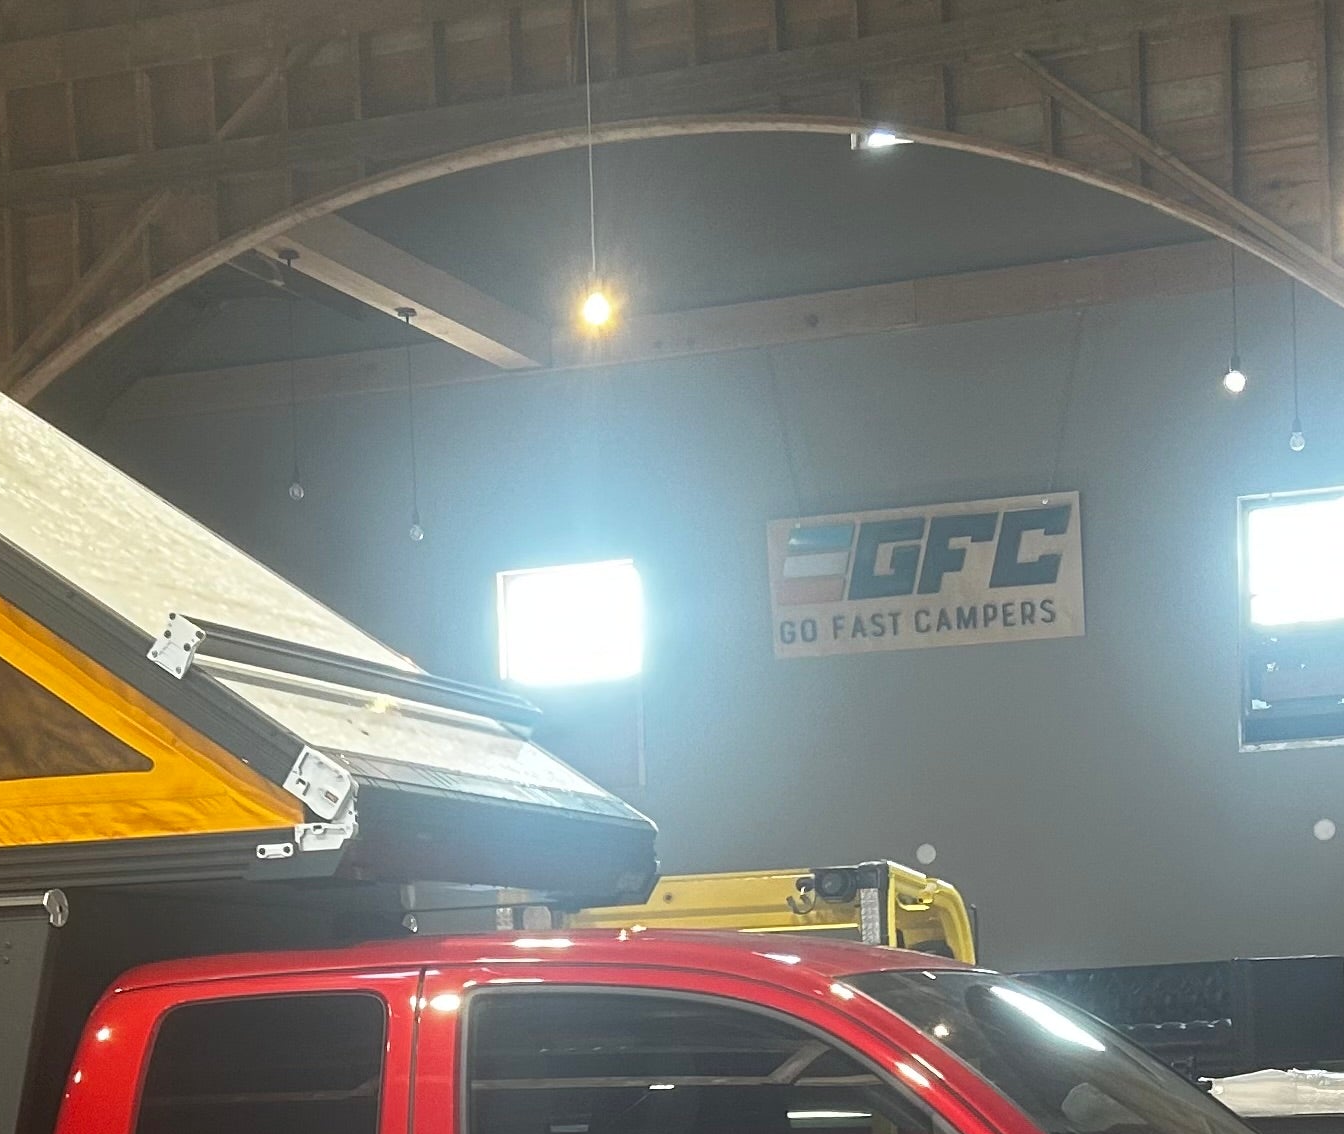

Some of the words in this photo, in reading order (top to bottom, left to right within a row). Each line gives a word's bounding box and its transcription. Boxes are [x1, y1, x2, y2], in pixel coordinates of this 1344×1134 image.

[848, 505, 1072, 600] GFC
[779, 617, 818, 645] GO
[832, 611, 901, 640] FAST
[914, 599, 1057, 634] CAMPERS
